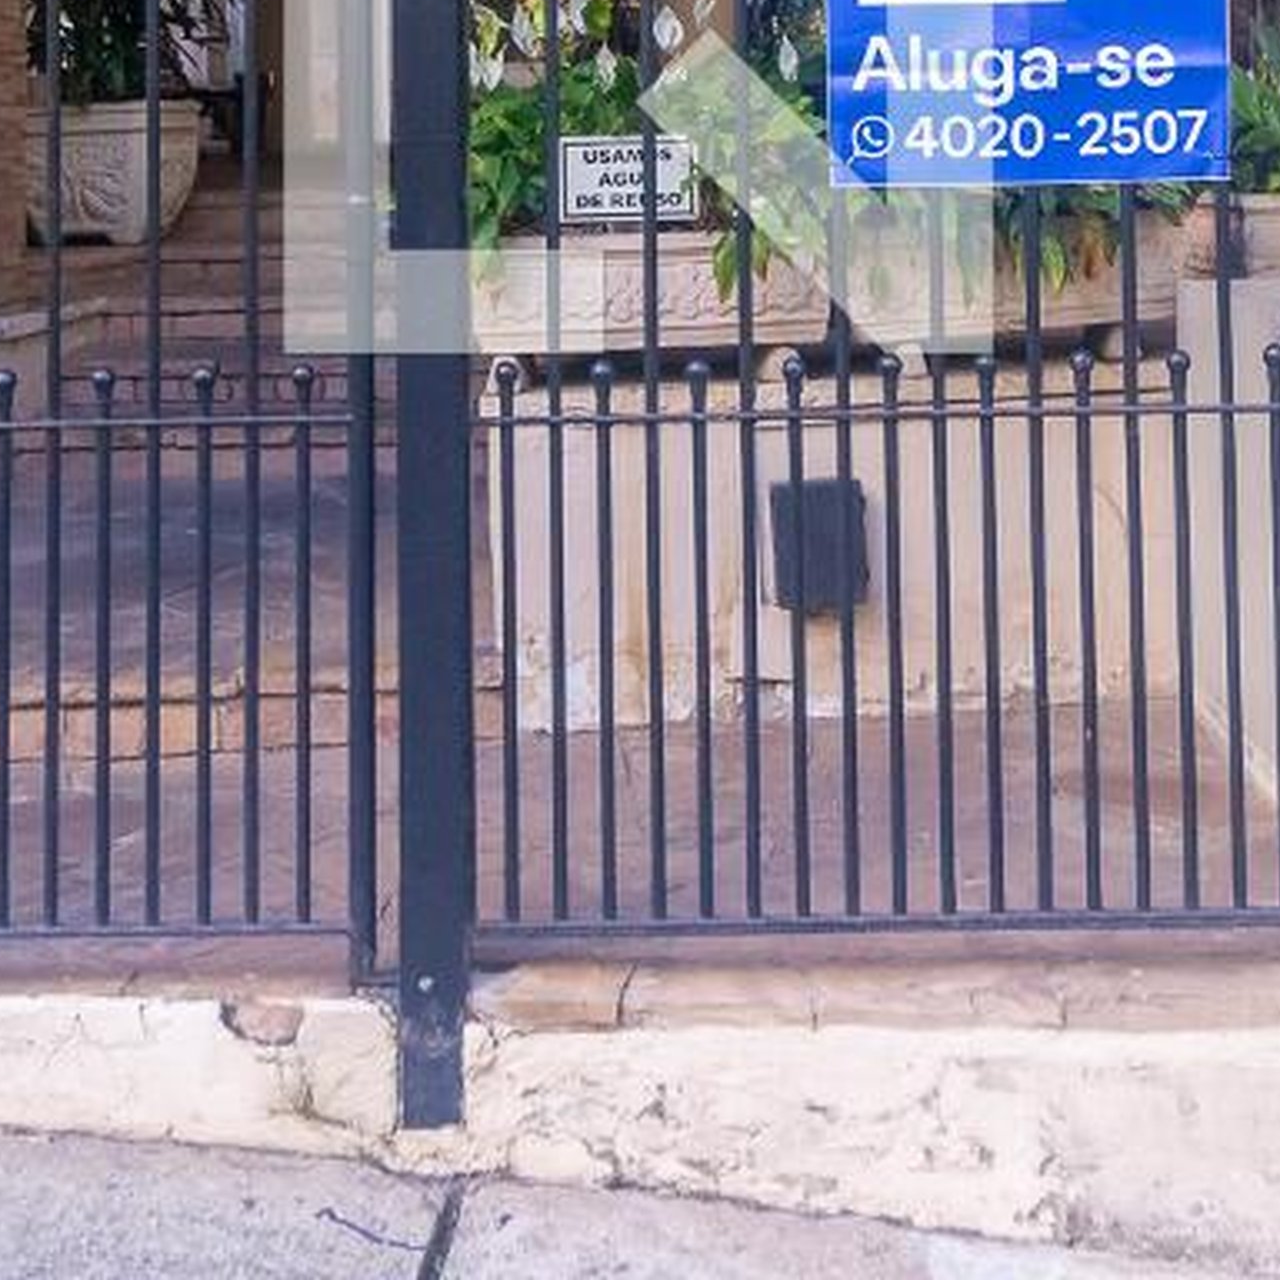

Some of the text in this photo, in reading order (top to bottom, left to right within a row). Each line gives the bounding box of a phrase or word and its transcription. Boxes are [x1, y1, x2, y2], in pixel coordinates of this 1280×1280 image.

[852, 35, 1175, 107] Aluga-se
[904, 109, 1208, 160] 4020-2507
[583, 148, 672, 164] USAMS
[576, 193, 602, 208] DE
